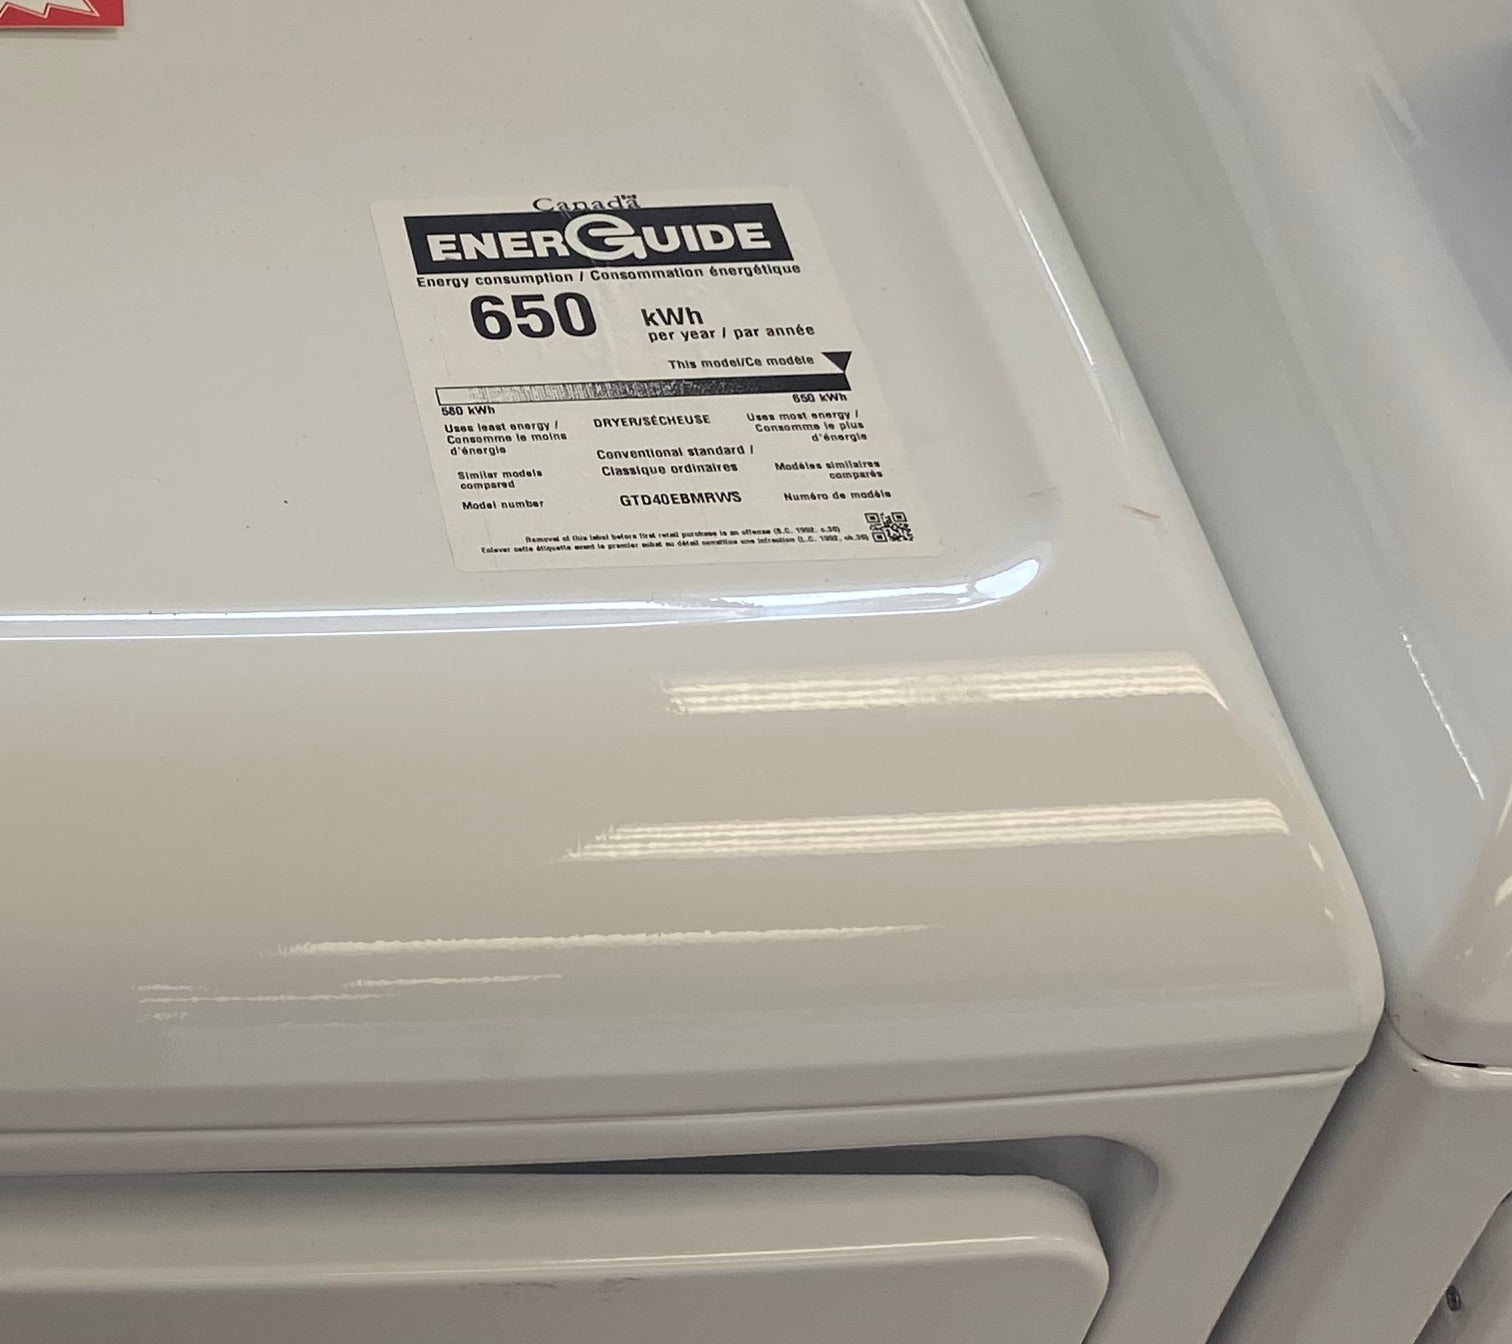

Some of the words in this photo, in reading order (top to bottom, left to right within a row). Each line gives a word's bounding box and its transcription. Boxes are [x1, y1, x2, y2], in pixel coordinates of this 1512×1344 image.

[416, 277, 469, 288] Energy
[475, 272, 574, 285] consumption
[590, 266, 704, 281] Consommation
[709, 264, 801, 276] énergétique
[470, 292, 597, 340] 650
[641, 307, 704, 327] kWh
[648, 331, 675, 343] per
[681, 331, 716, 342] year
[734, 328, 759, 340] par
[766, 325, 816, 337] année
[668, 359, 697, 369] This
[701, 357, 762, 368] model/Ce
[766, 355, 814, 366] modèle
[792, 393, 815, 403] 650
[820, 393, 848, 402] kWh
[468, 405, 496, 415] kWh
[593, 414, 711, 428] DRYER/SÉCHEUSE
[747, 413, 775, 422] Uses
[779, 412, 807, 421] most
[811, 412, 850, 420] energy
[445, 424, 474, 433] Uses
[478, 423, 506, 432] least
[510, 422, 550, 430] energy
[840, 422, 864, 431] plus
[447, 435, 512, 445] Consomme
[516, 434, 527, 442] le
[532, 432, 568, 441] moins
[596, 447, 683, 460] Conventional
[687, 445, 745, 457] standard
[601, 465, 666, 476] Classique
[671, 463, 738, 474] ordinaires
[826, 461, 880, 469] similaires
[458, 471, 498, 480] Similar
[502, 469, 543, 478] models
[460, 481, 515, 490] compared
[462, 501, 497, 510] Model
[501, 500, 544, 509] number
[620, 491, 742, 506] GTD40EBMRWS
